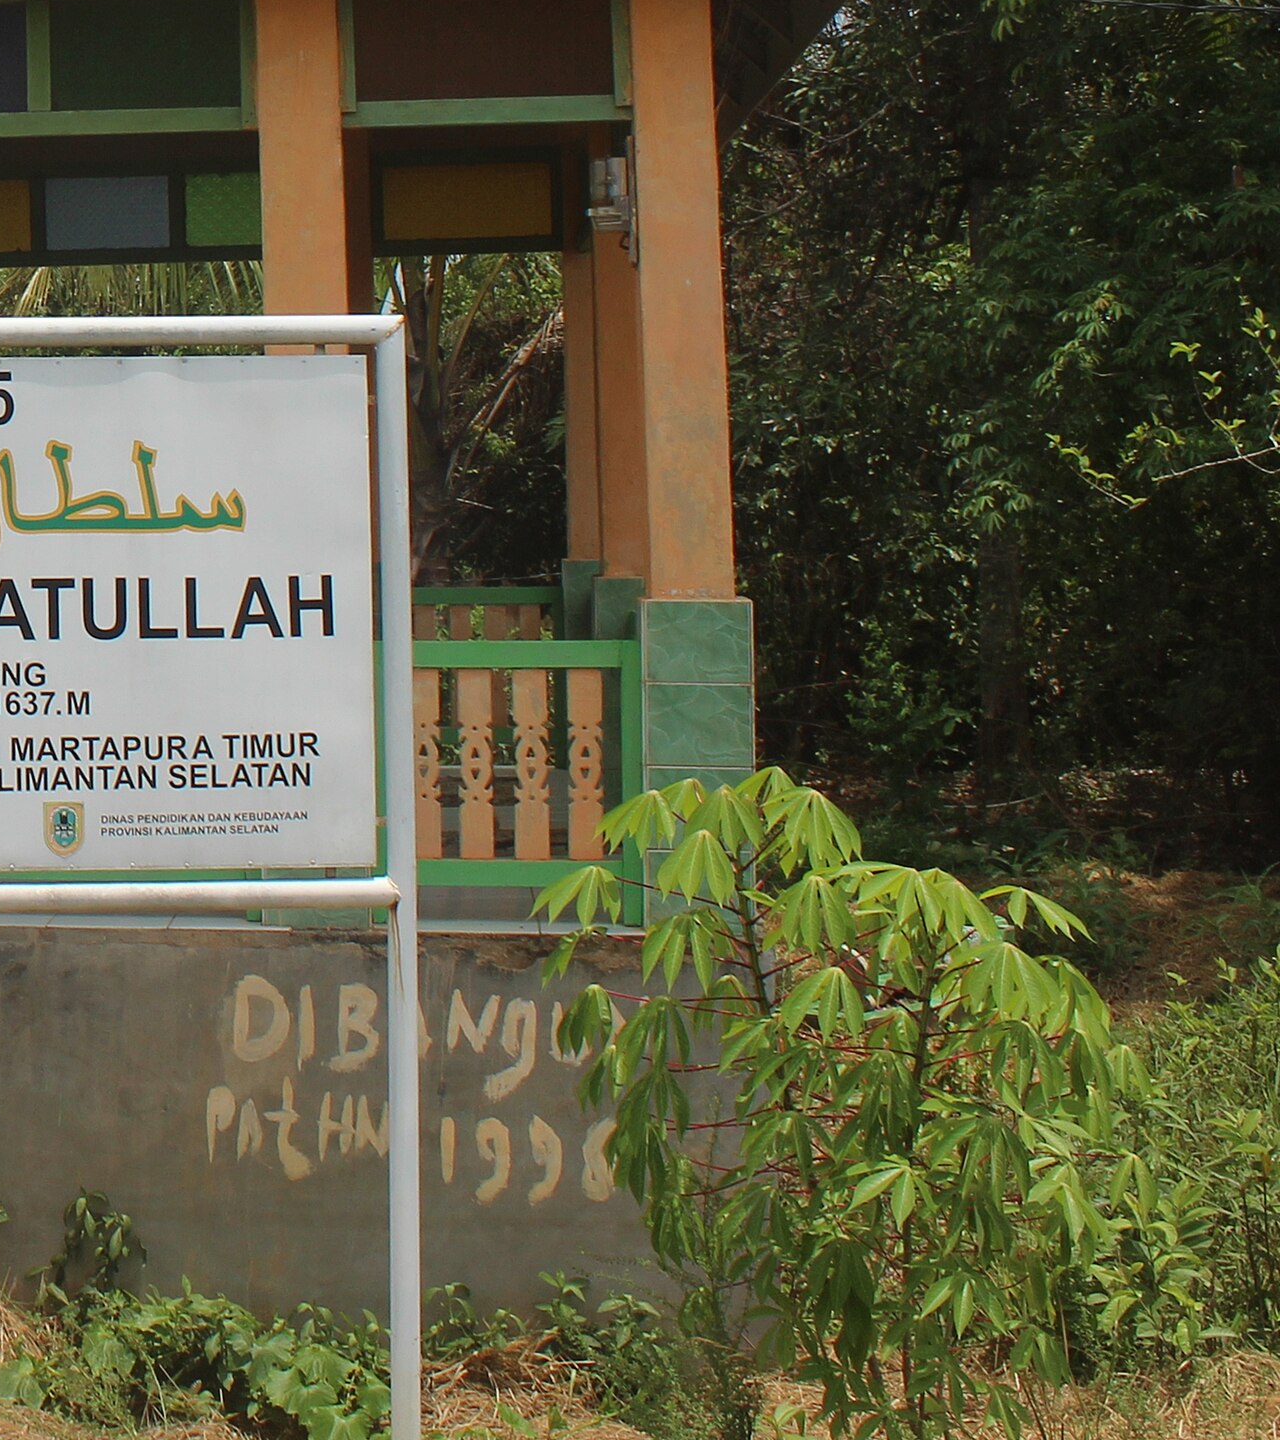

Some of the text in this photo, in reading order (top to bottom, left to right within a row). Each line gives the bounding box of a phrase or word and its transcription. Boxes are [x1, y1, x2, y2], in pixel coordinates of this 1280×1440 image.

[11, 735, 214, 762] MARTAPURA
[221, 732, 320, 759] TIMUR
[168, 762, 311, 789] SELATAN
[100, 811, 308, 824] DINAS PENDIDIKAN DAN KEBUDAYAAN
[100, 824, 279, 836] PROVINSI KALIMANTAN SELATAN
